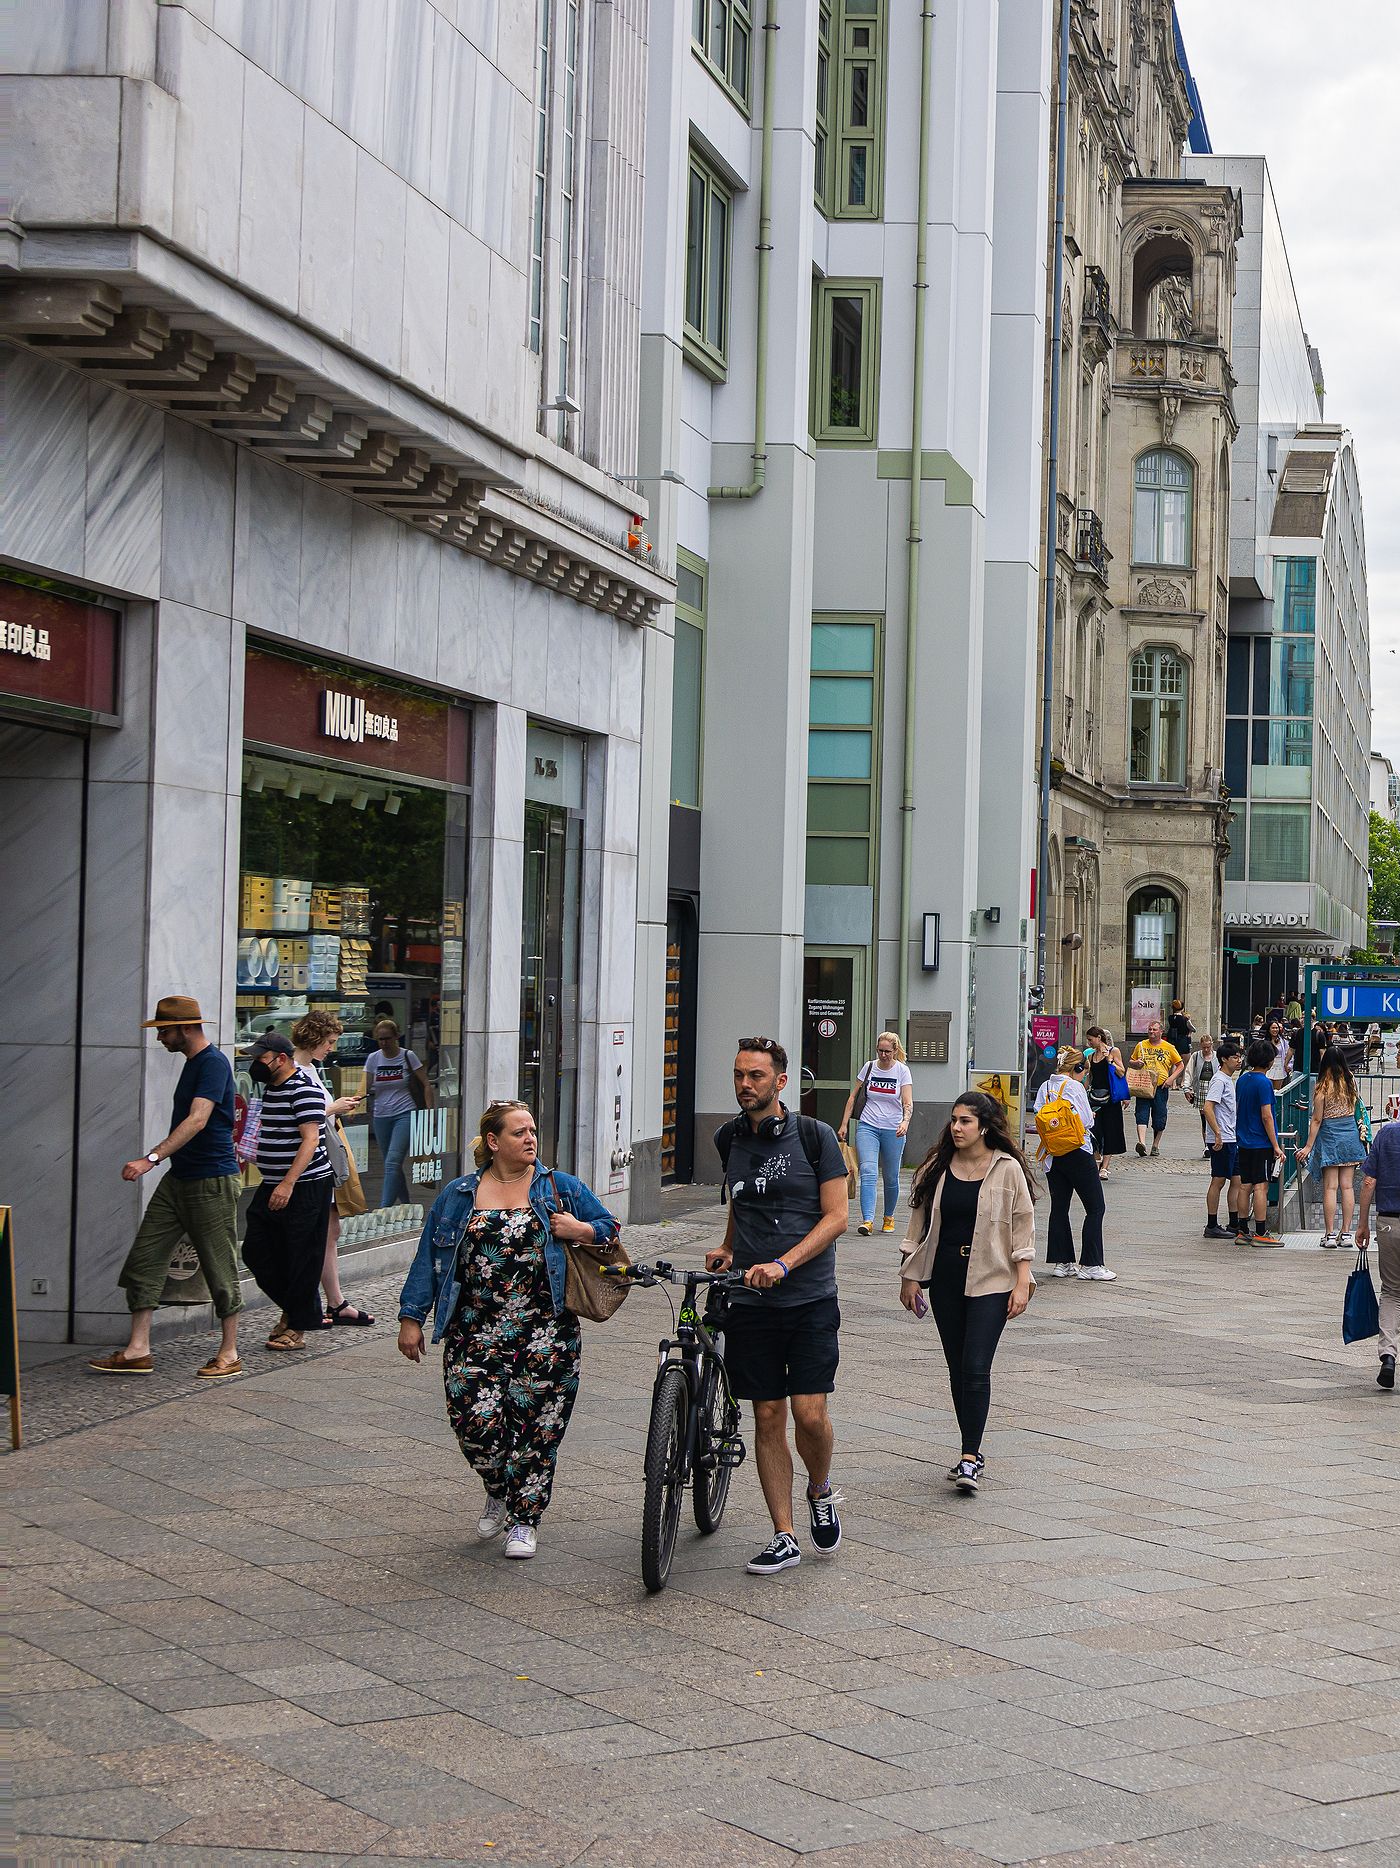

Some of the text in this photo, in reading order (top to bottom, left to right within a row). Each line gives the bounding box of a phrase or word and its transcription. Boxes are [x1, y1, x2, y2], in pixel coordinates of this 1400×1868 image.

[325, 690, 399, 743] MUJI 無印良品
[1224, 912, 1309, 926] ARSTADT
[1258, 943, 1335, 955] KARSTADT
[1137, 1000, 1155, 1009] Sale
[1327, 988, 1348, 1014] U
[409, 1107, 448, 1157] MUJI
[412, 1160, 443, 1184] 無印良品
